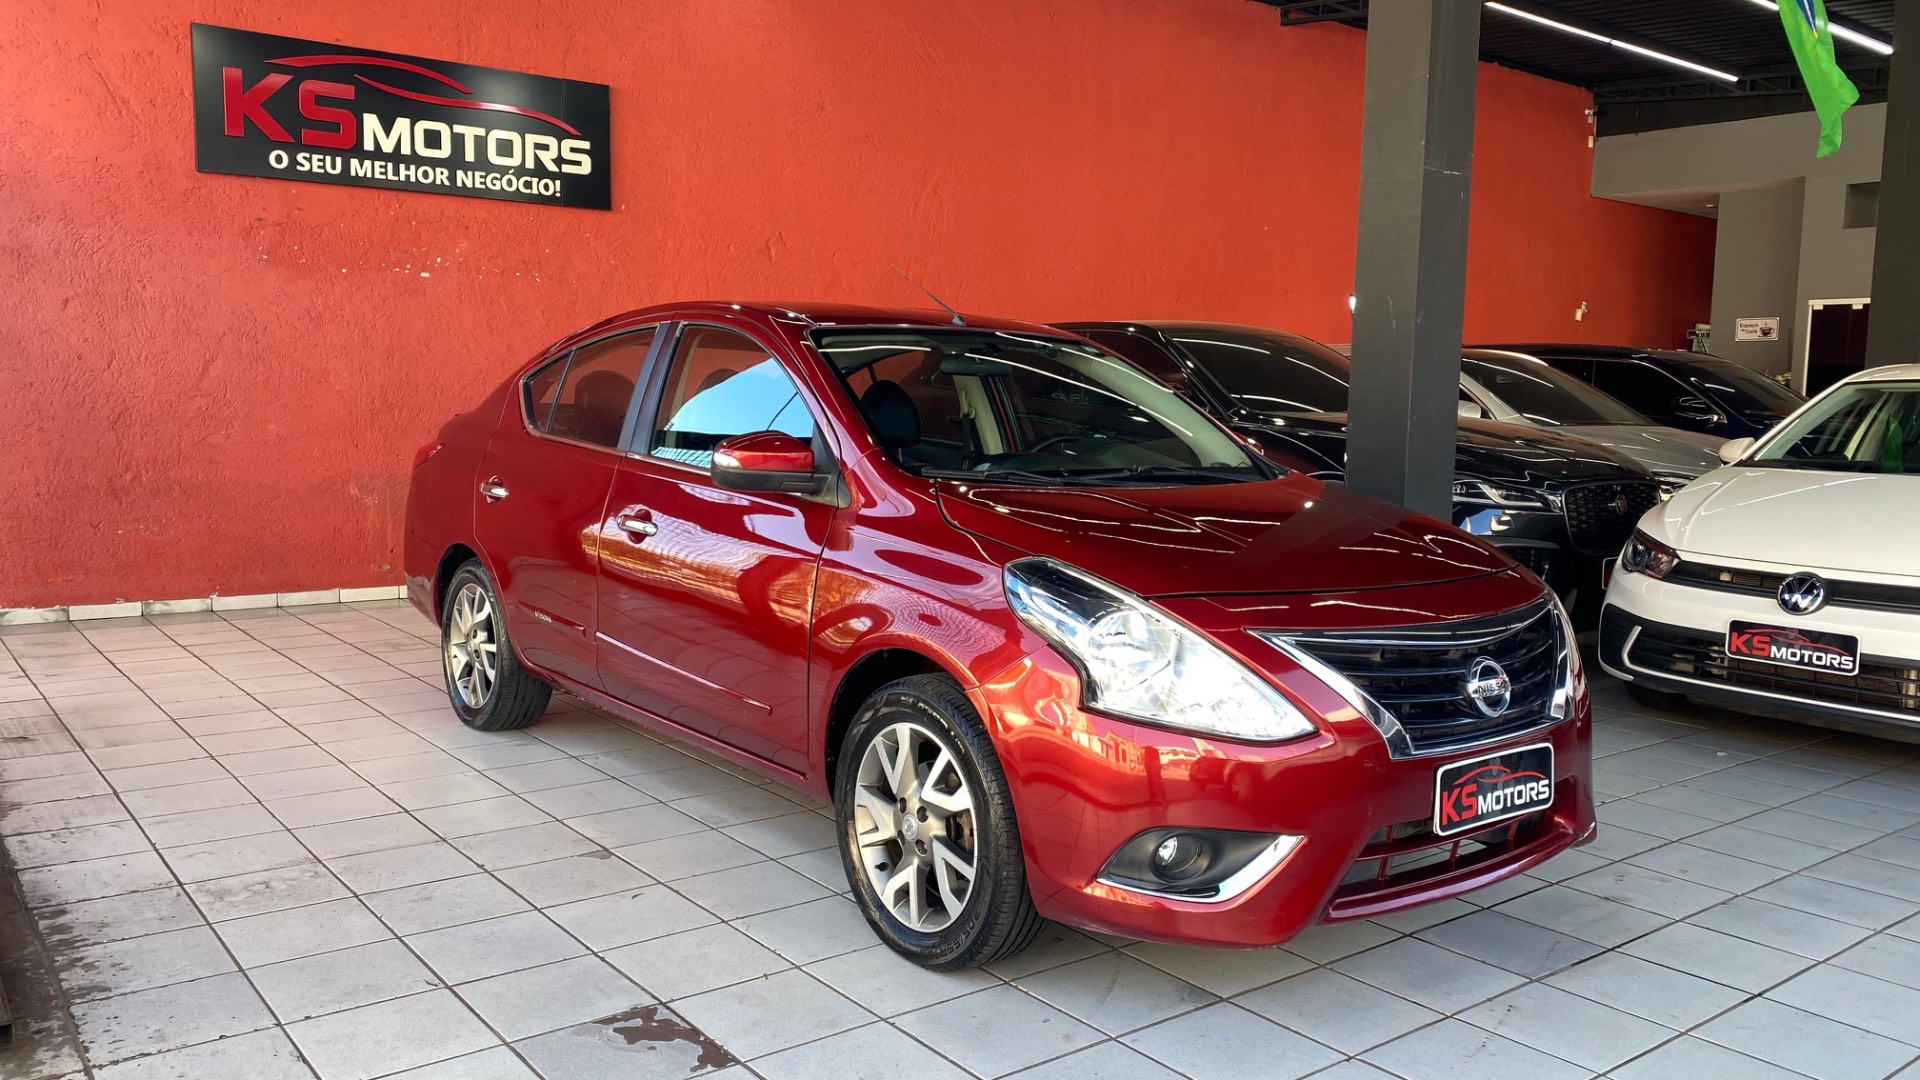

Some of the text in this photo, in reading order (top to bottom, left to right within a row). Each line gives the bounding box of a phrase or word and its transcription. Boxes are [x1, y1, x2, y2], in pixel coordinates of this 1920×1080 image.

[222, 66, 592, 175] KS MOTORS
[268, 149, 562, 197] O SEU MELHOR NEGÓCIO!
[1731, 631, 1854, 670] KS MOTORS
[1441, 778, 1550, 826] KS MOTORS
